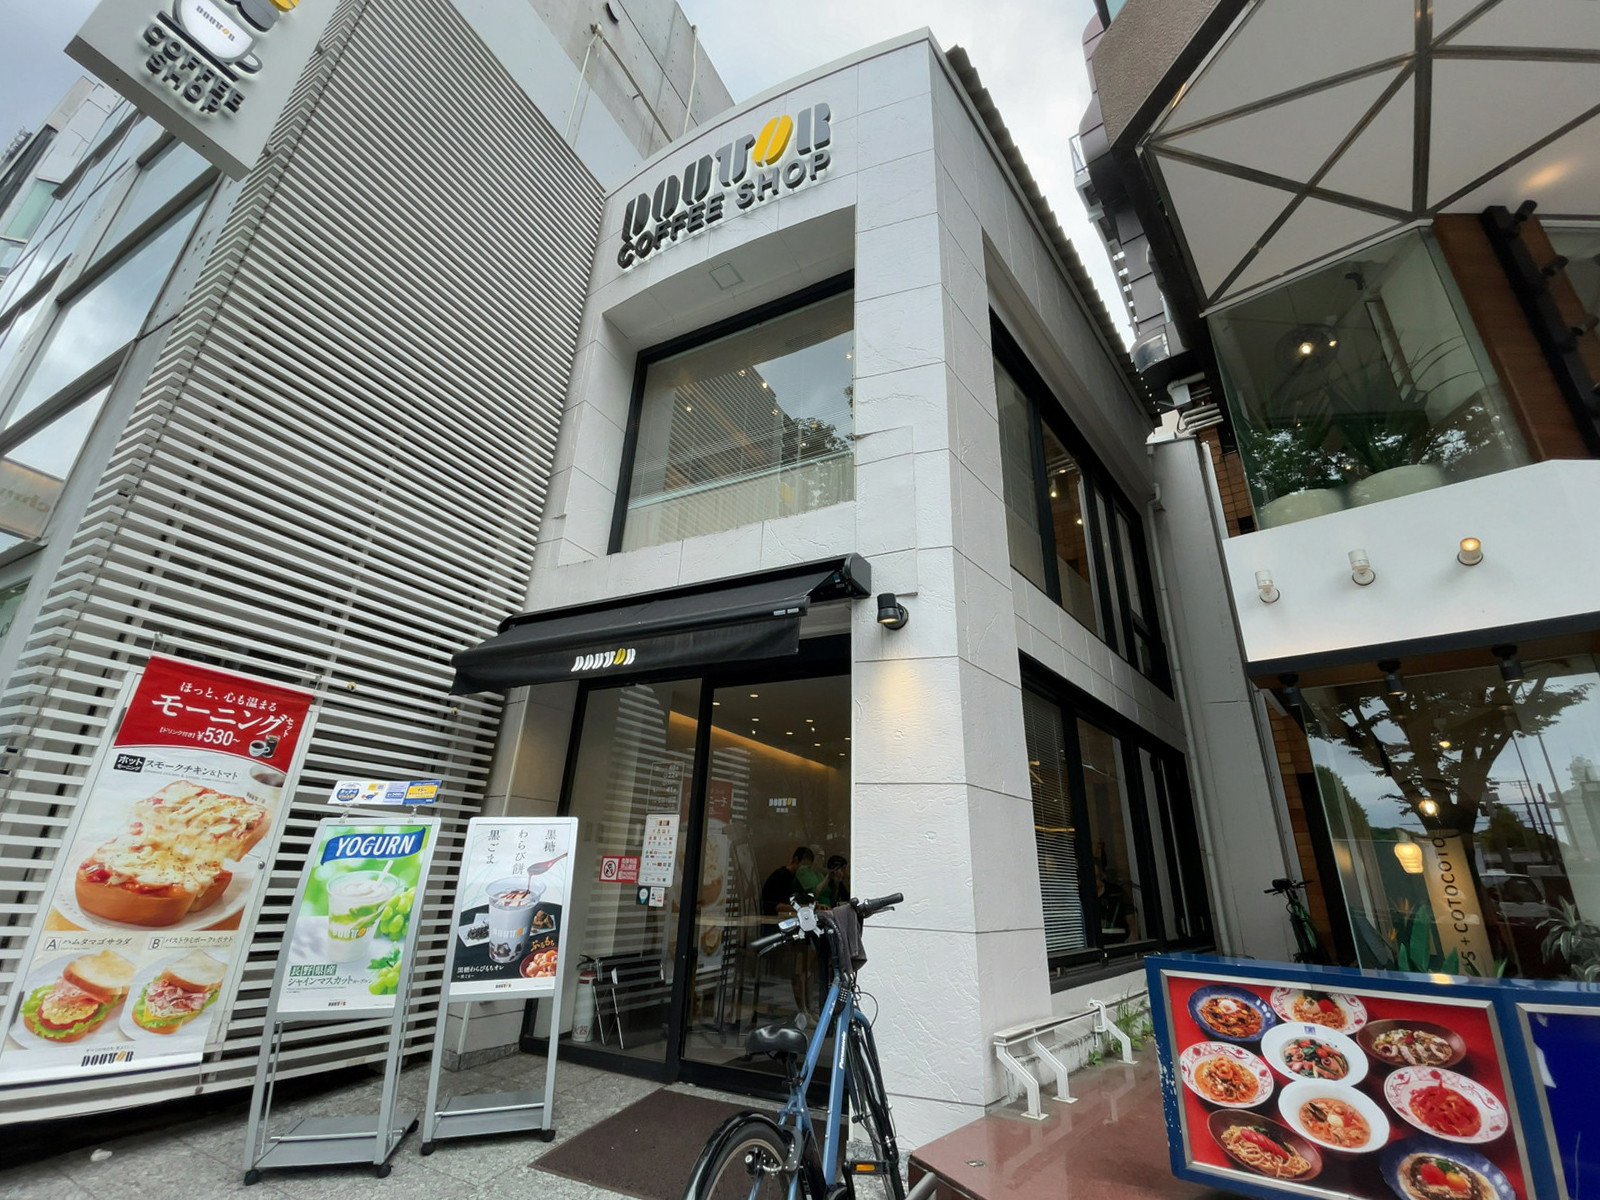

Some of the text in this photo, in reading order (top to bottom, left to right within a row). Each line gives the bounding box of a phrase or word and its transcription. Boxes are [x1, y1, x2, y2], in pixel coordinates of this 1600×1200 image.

[143, 23, 245, 114] COFFEE
[146, 52, 221, 114] SHOP
[621, 102, 832, 243] DOUTOR
[617, 149, 831, 269] COFFEE SHOP
[570, 647, 637, 672] DOUTOR
[180, 681, 277, 712] ほっと、心も温まる
[152, 693, 287, 736] モーニング
[118, 755, 143, 766] ホット
[335, 834, 416, 858] YOGURN
[486, 828, 501, 865] 黒ごま
[512, 828, 529, 875] わらび餅
[46, 938, 57, 950] A
[151, 938, 161, 949] B
[289, 963, 338, 977] 長野県産
[81, 1051, 135, 1067] DOUTOR
